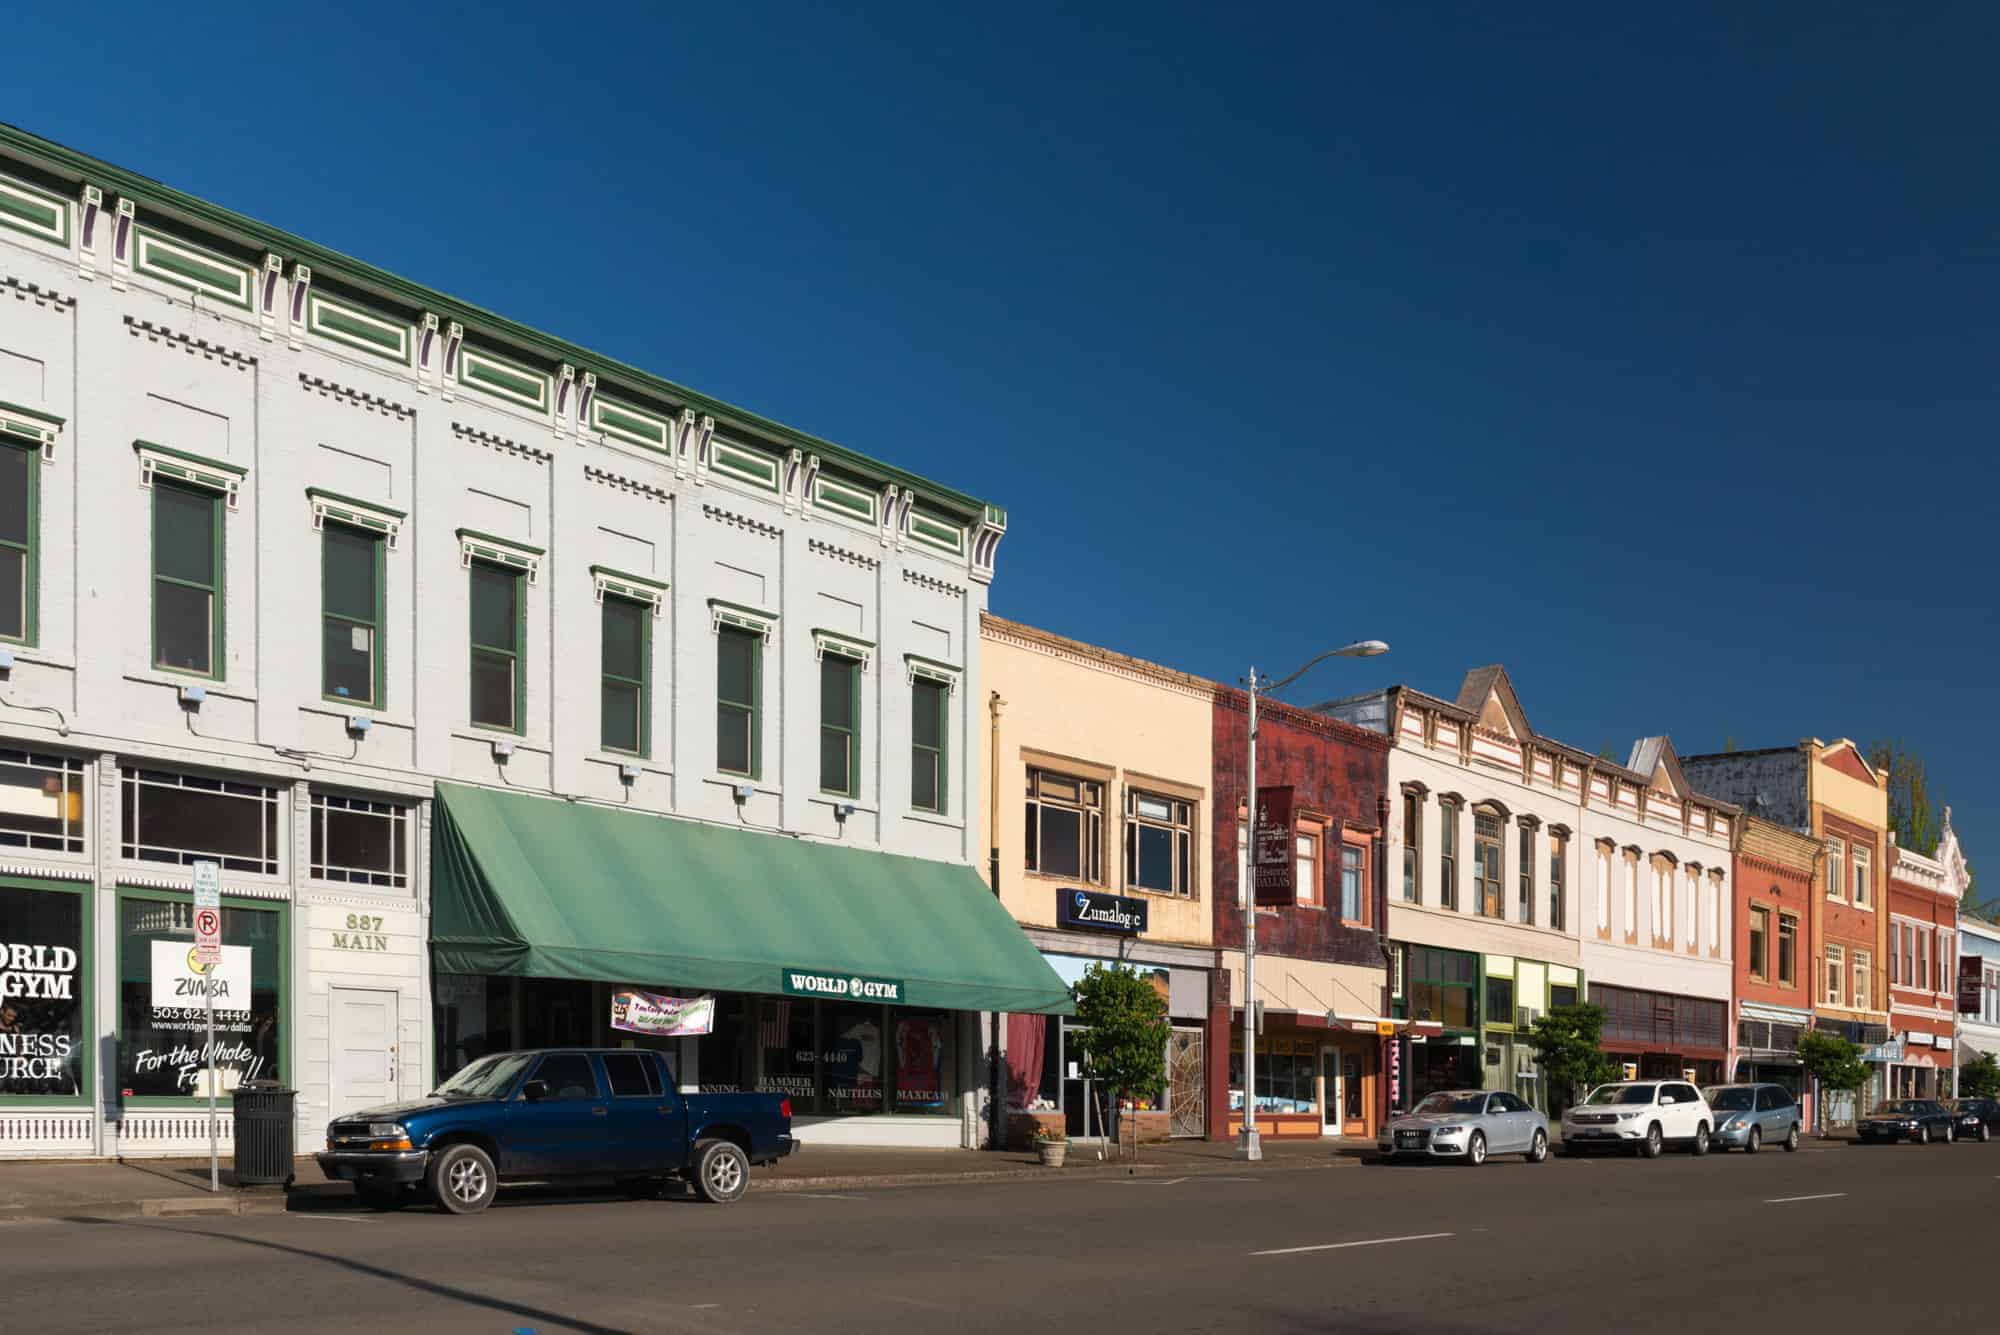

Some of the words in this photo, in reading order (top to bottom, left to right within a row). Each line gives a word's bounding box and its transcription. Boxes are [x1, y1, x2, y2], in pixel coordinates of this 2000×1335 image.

[346, 913, 384, 931] 887
[332, 933, 389, 951] MAIN
[0, 971, 73, 999] GYM
[174, 978, 230, 998] ZUMBA
[790, 974, 848, 994] WORLD
[863, 982, 898, 999] GYM
[151, 1021, 252, 1033] www.worldgymcom/dallas
[136, 1049, 168, 1074] For
[168, 1044, 199, 1067] the
[828, 1088, 882, 1099] NAUTILUS
